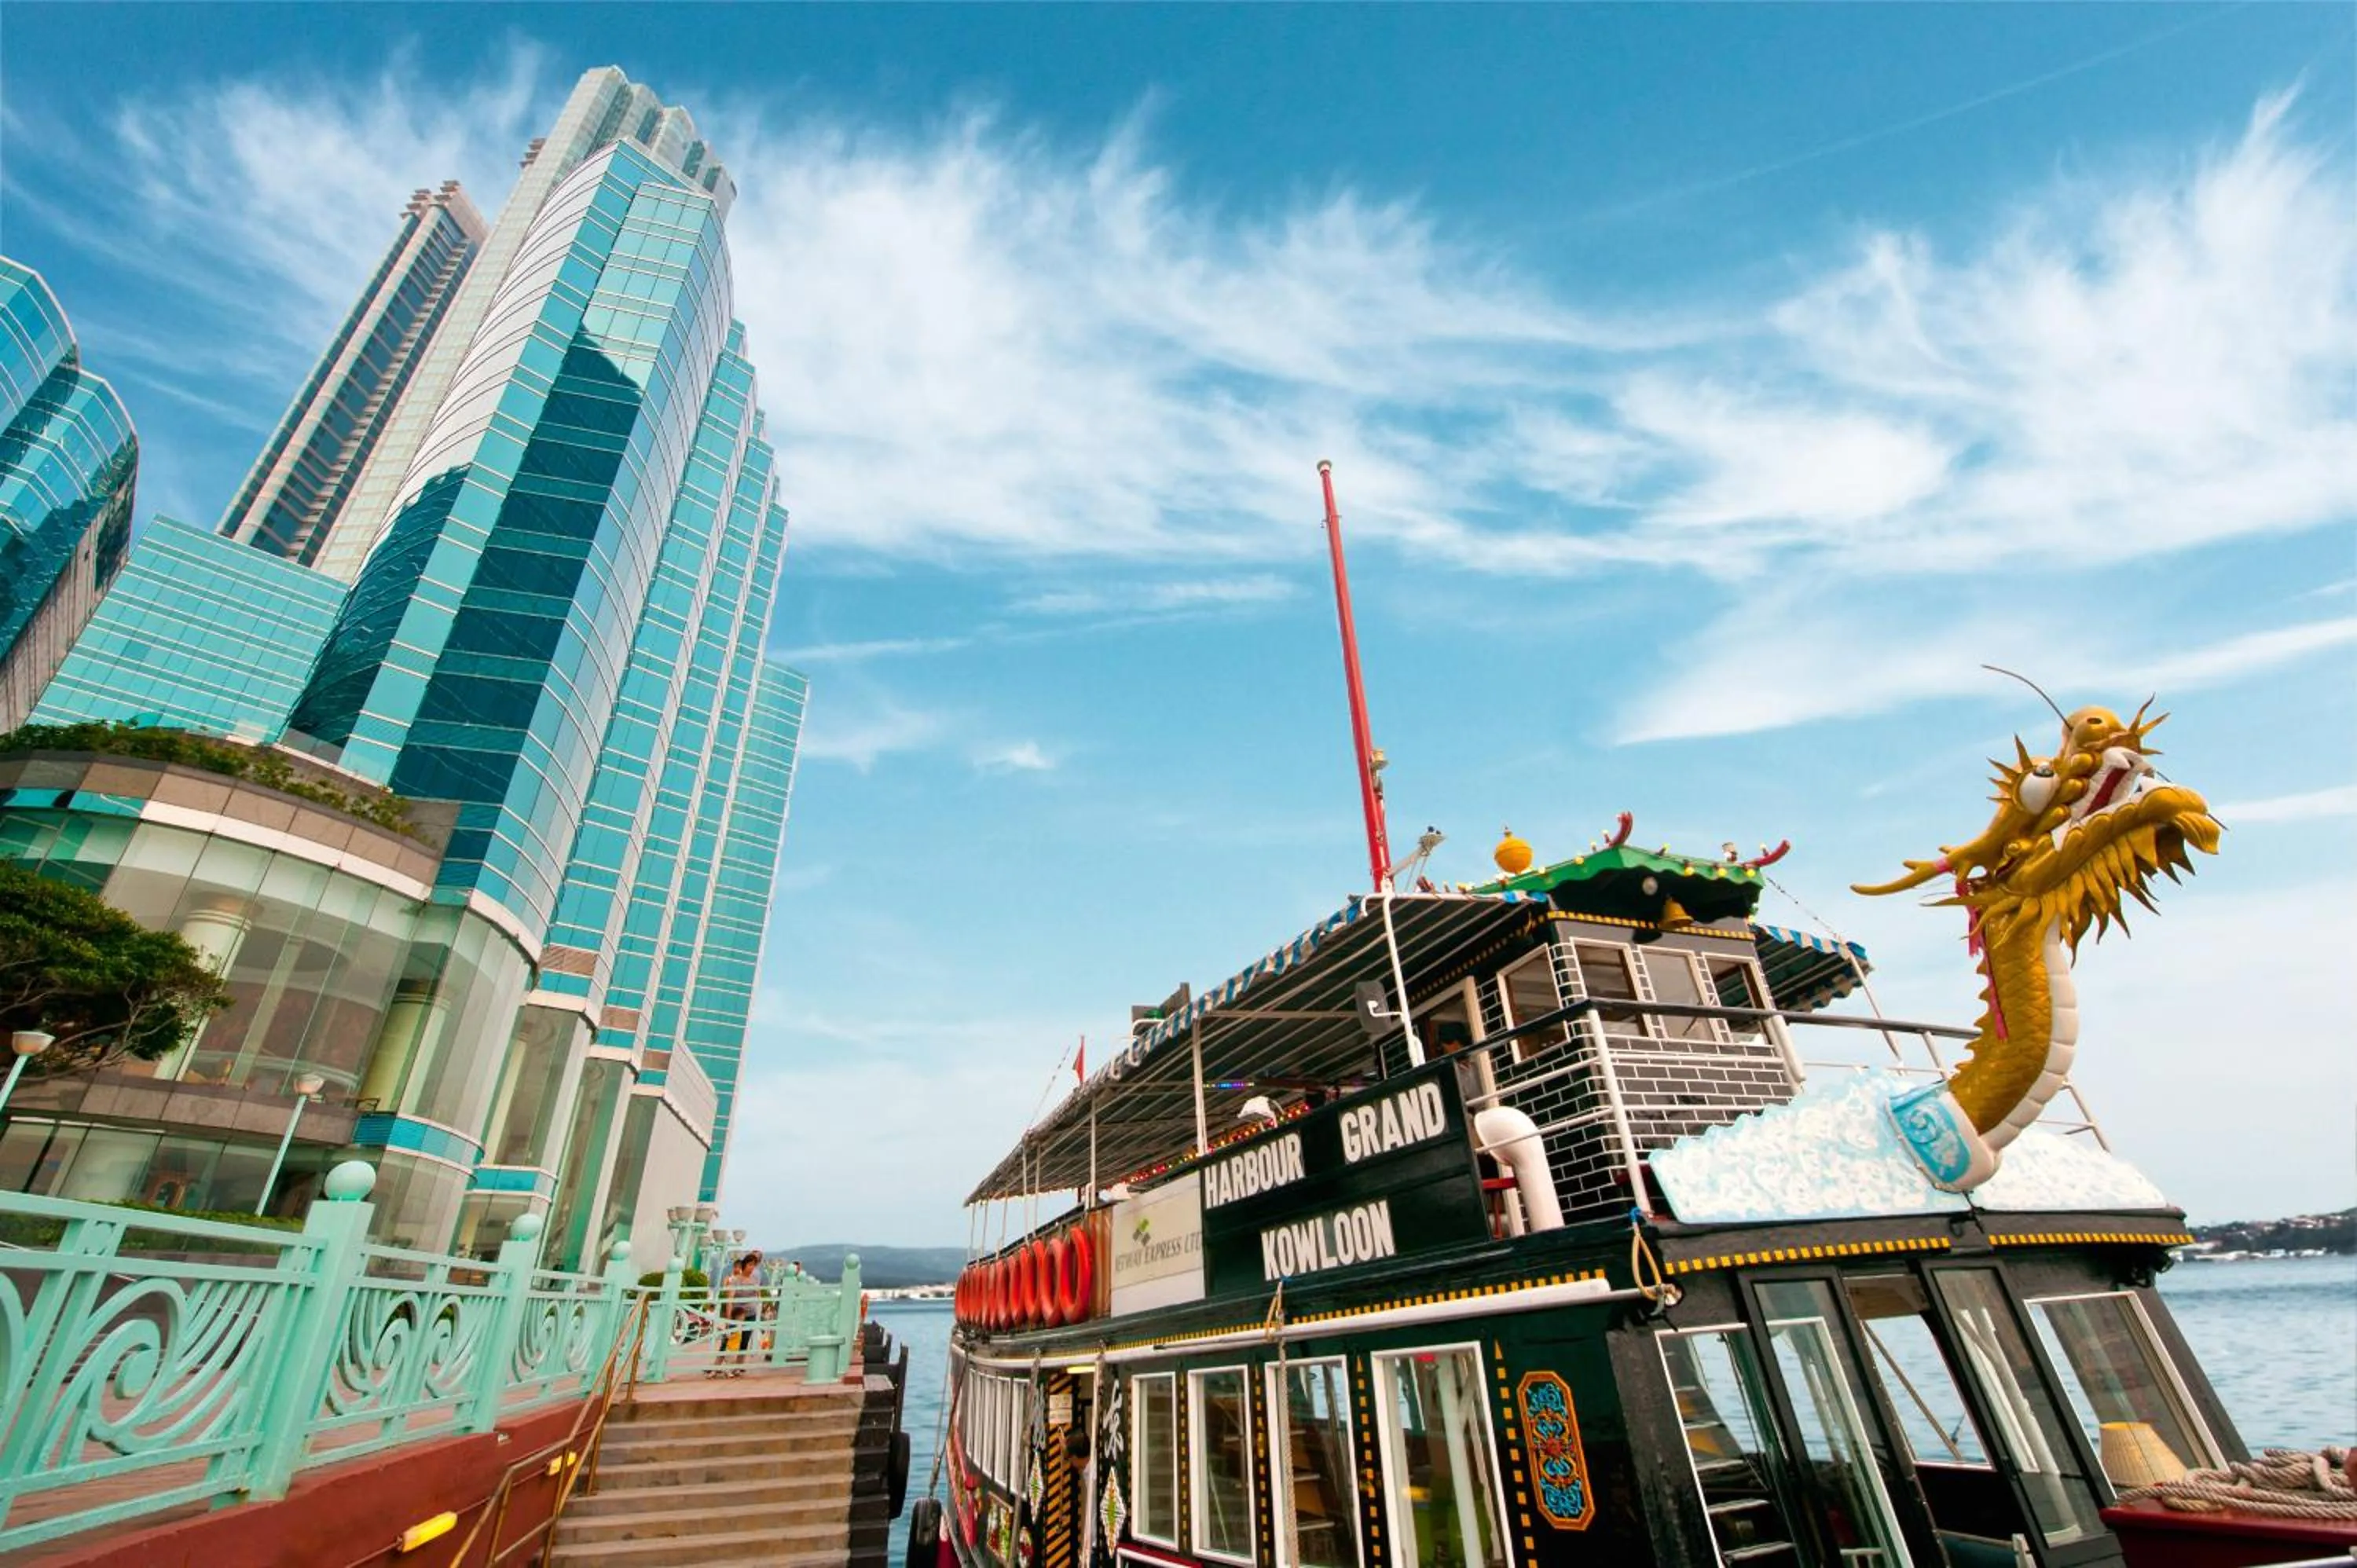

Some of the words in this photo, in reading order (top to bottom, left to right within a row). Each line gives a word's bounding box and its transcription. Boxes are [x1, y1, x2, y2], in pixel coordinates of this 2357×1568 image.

[1204, 1133, 1304, 1209] HARBOUR
[1340, 1082, 1445, 1162] GRAND
[1145, 1236, 1182, 1264] EXPRESS
[1261, 1200, 1396, 1281] KOWLOON
